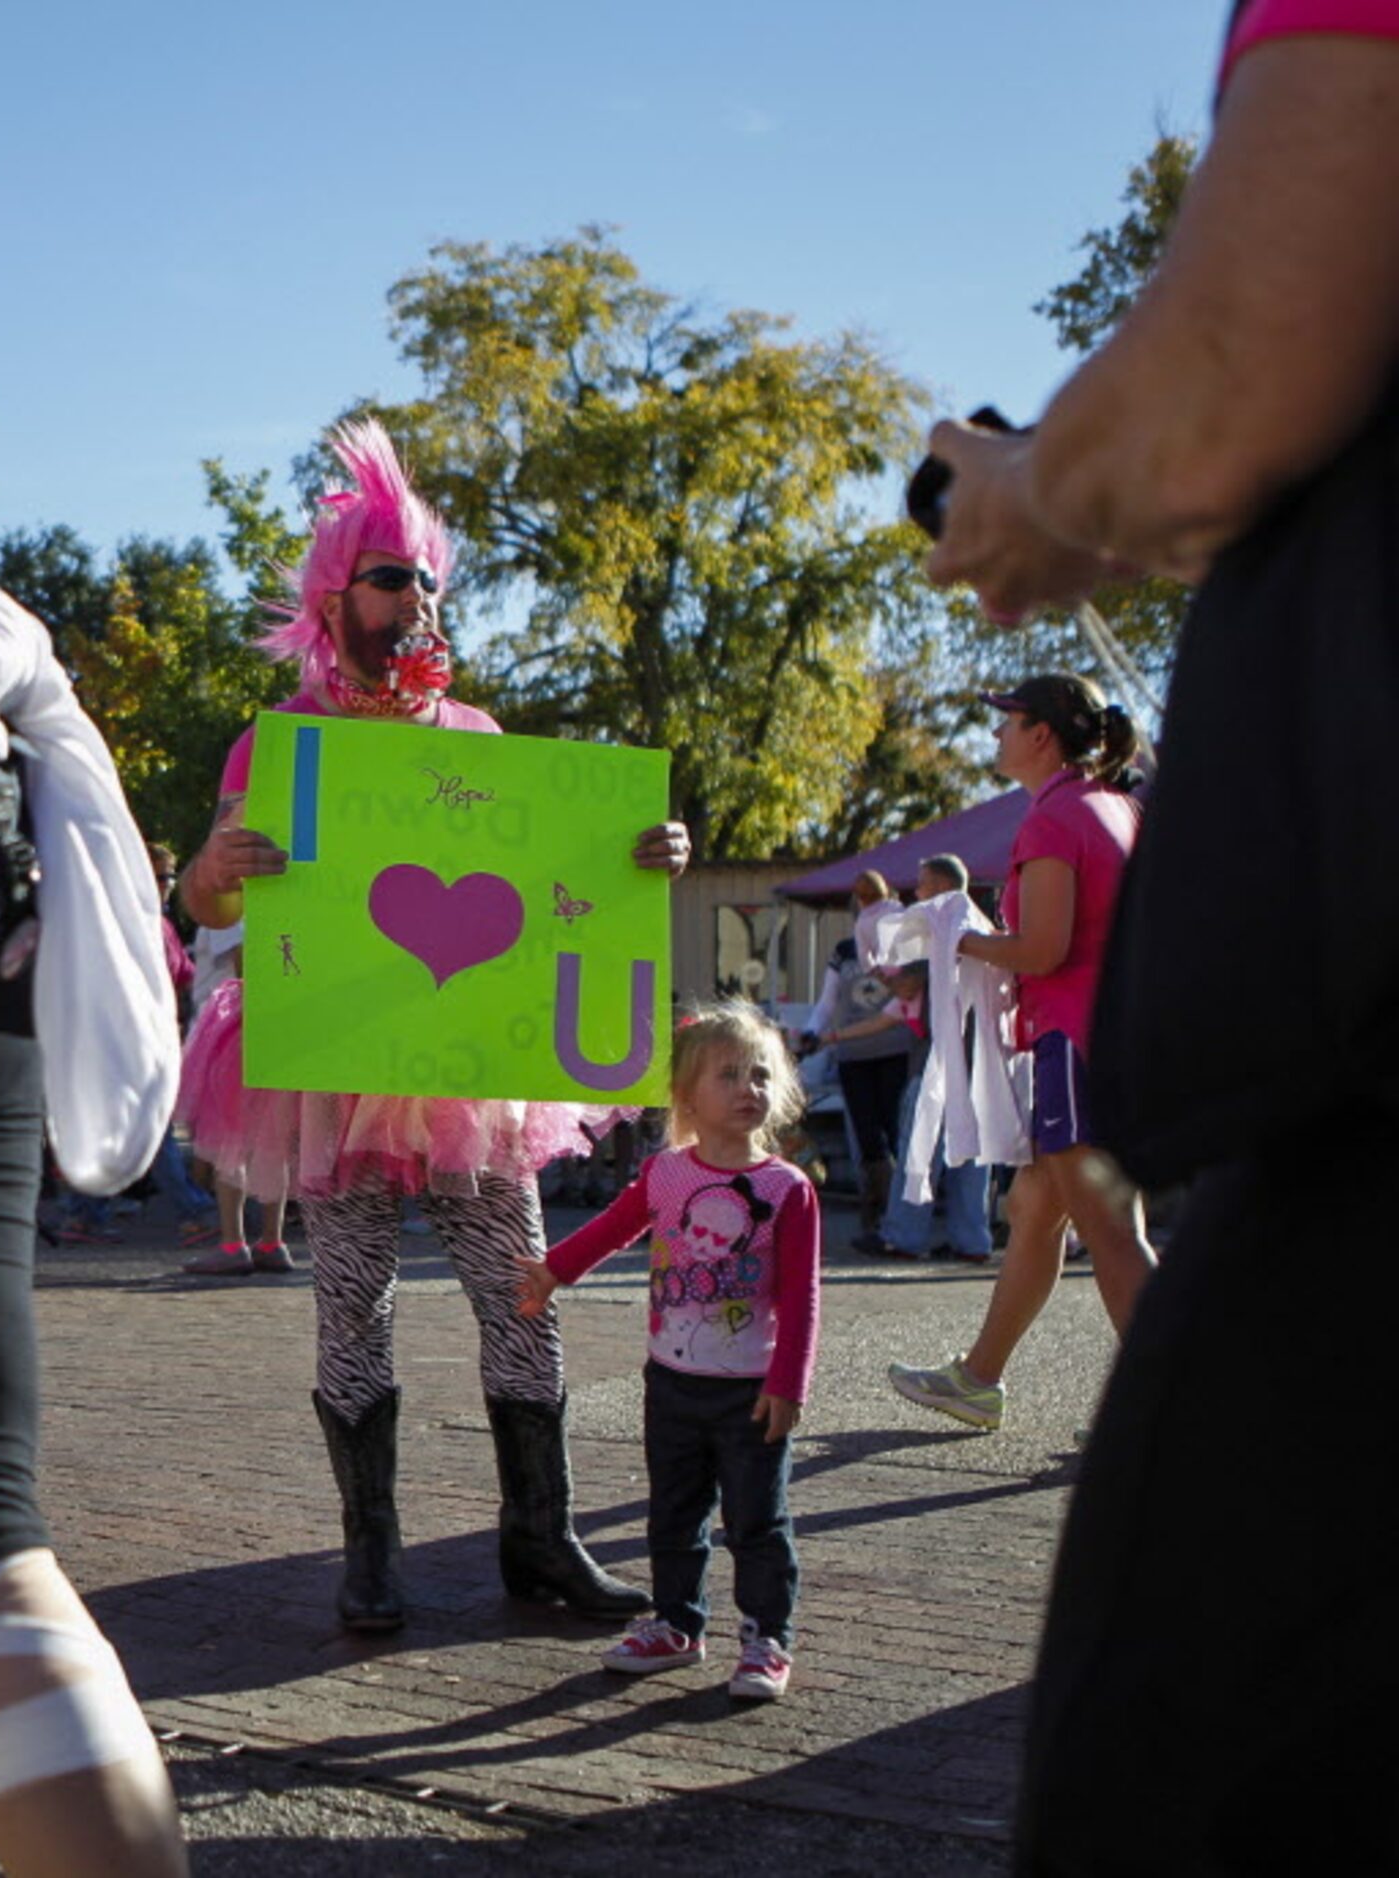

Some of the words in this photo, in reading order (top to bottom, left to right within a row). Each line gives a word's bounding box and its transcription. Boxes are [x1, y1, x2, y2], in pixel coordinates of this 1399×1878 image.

[292, 727, 321, 861] I
[421, 766, 496, 811] Hope
[554, 952, 656, 1092] U
